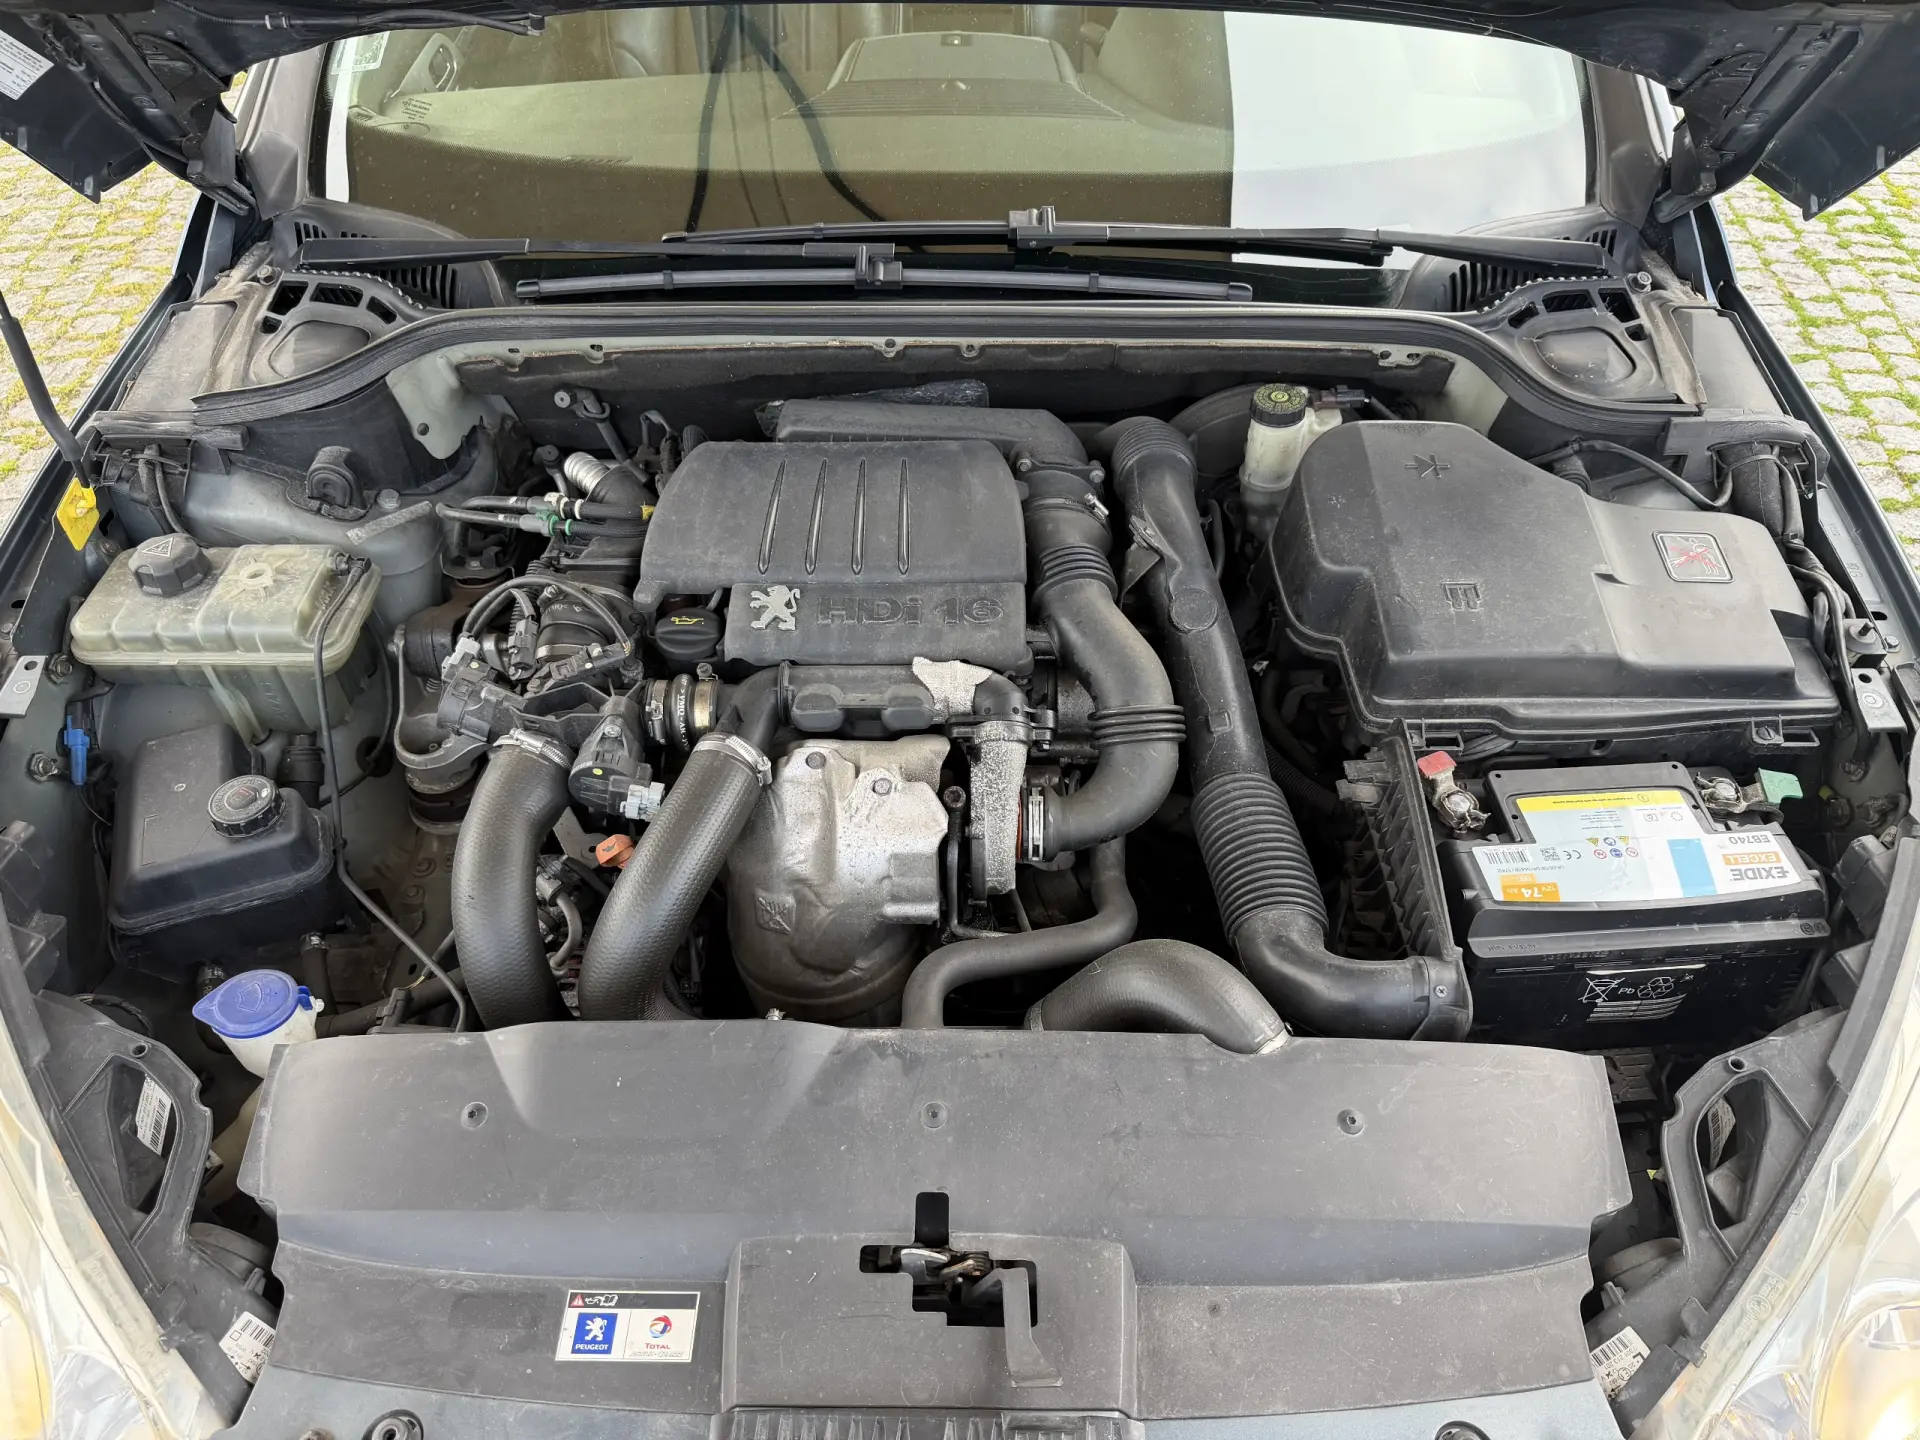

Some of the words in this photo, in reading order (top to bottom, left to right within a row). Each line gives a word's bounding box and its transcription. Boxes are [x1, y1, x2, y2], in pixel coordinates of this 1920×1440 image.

[817, 595, 922, 625] HDi
[934, 596, 1004, 625] 16
[1729, 834, 1771, 844] EB740
[1727, 853, 1777, 865] EXCELL
[1730, 866, 1789, 881] EXIDE
[1521, 887, 1542, 898] 74
[1617, 987, 1636, 995] Pb
[645, 1342, 671, 1350] TOTAL
